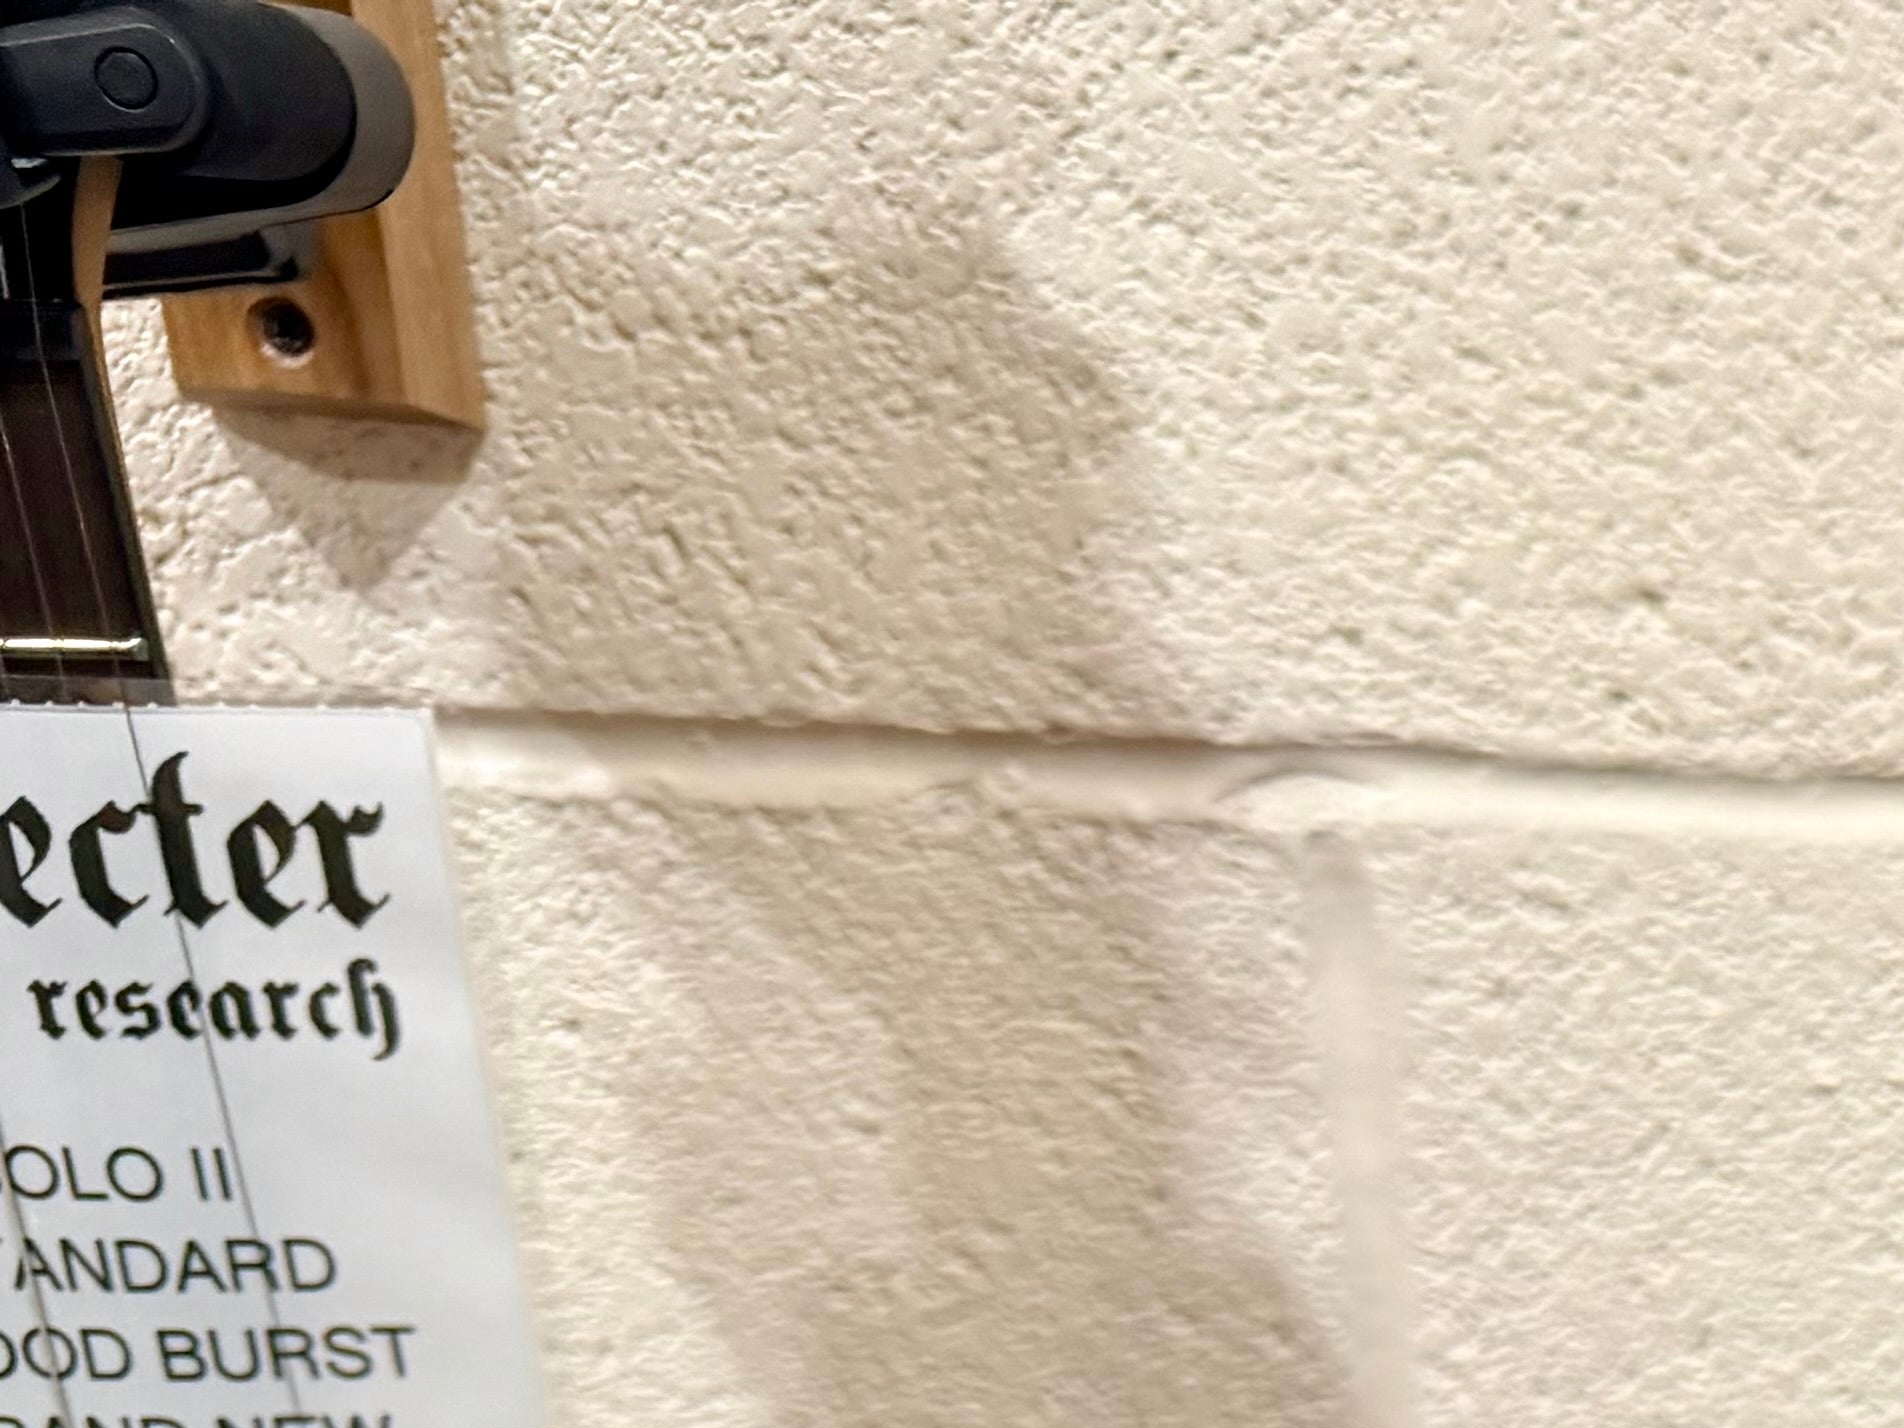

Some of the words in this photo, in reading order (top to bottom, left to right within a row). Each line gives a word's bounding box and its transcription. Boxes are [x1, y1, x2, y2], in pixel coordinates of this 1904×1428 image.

[27, 958, 402, 1061] research
[0, 1145, 164, 1201] OLO
[191, 1147, 232, 1201] II
[0, 1238, 336, 1293] ANDARD
[157, 1325, 416, 1382] BURST
